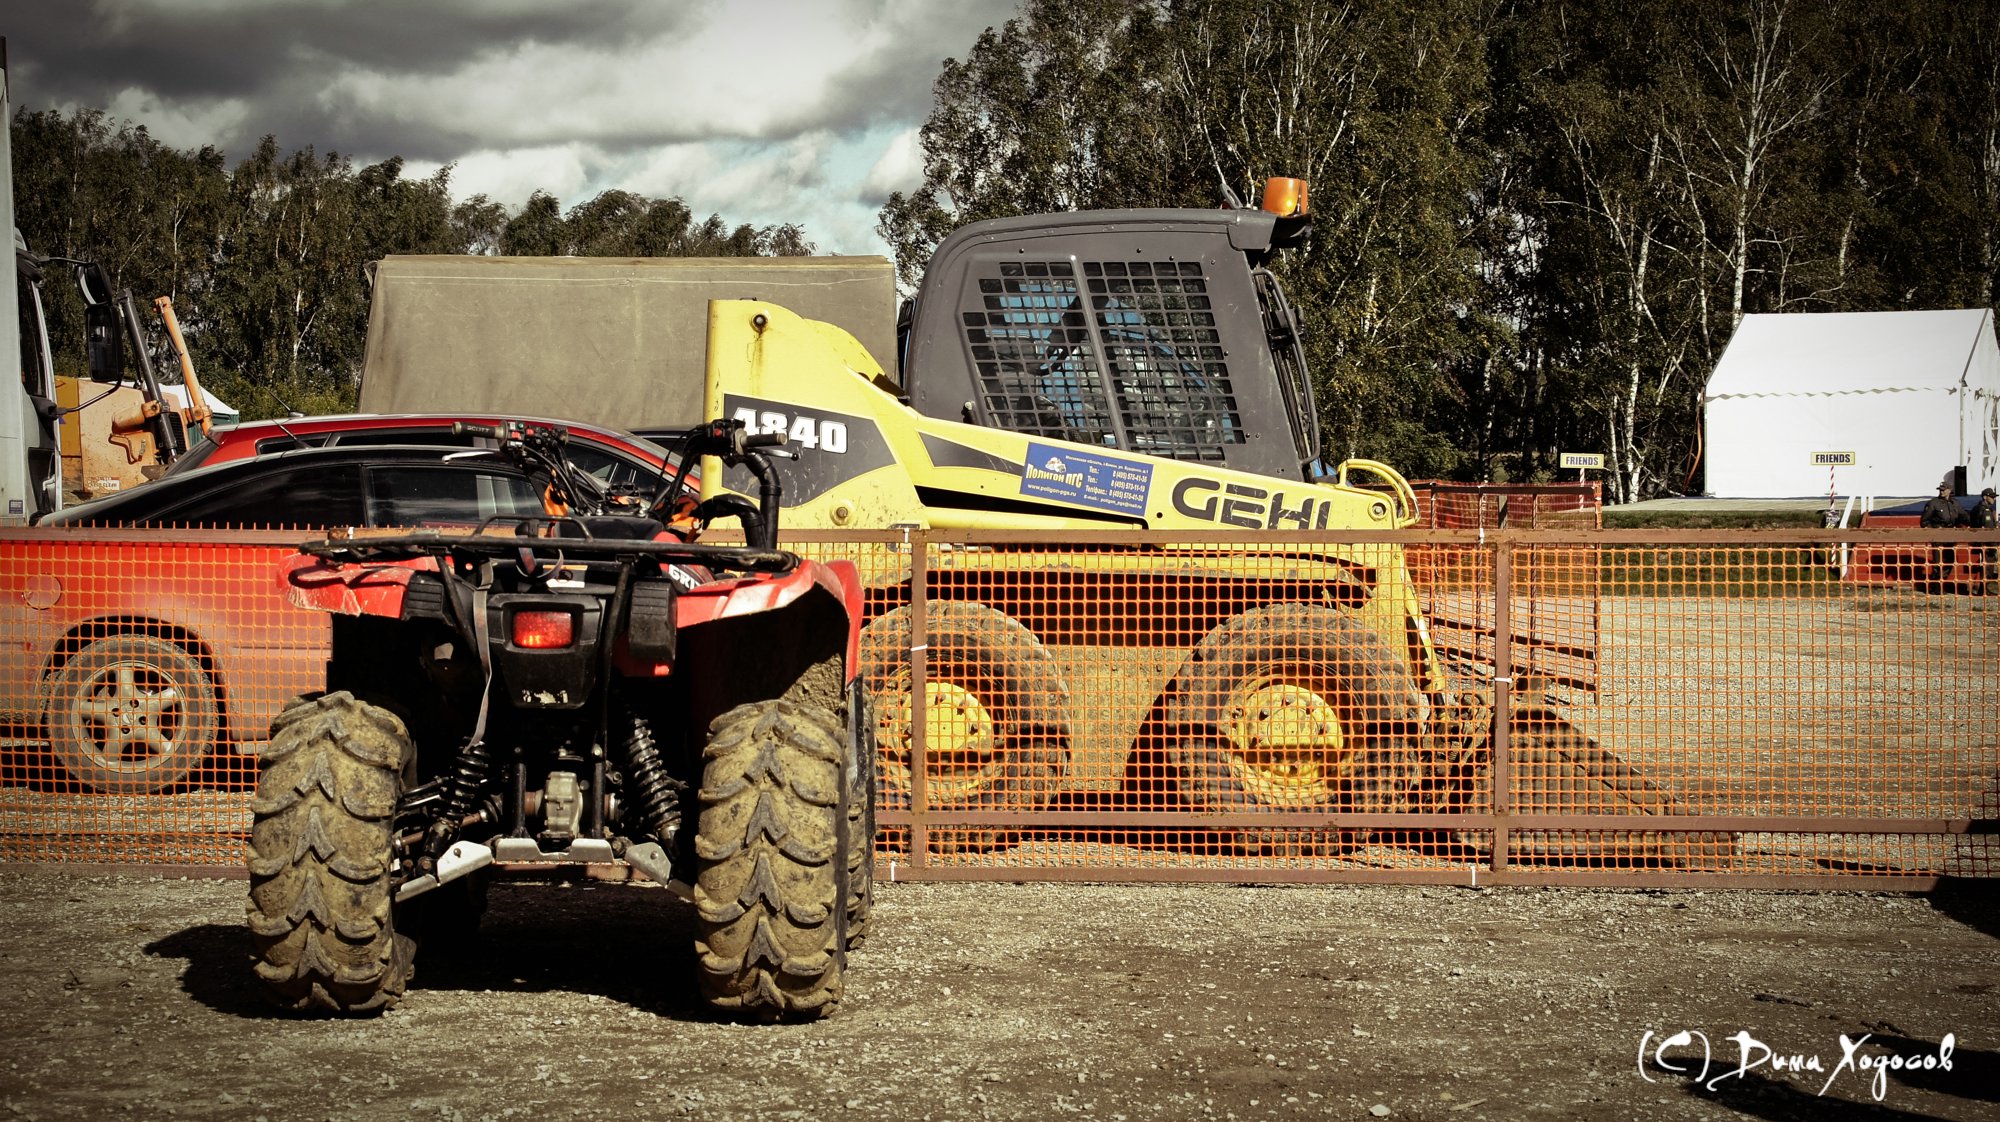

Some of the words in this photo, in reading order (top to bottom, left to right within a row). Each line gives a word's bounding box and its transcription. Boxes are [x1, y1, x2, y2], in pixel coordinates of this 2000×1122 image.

[732, 407, 848, 454] 4840
[1565, 455, 1599, 466] FRIENDS
[1815, 453, 1851, 463] FRIENDS
[1026, 464, 1064, 483] Полигон
[1066, 472, 1083, 488] ПГС
[1028, 484, 1076, 497] www.poligon-pgs.ru
[669, 564, 701, 590] GRI
